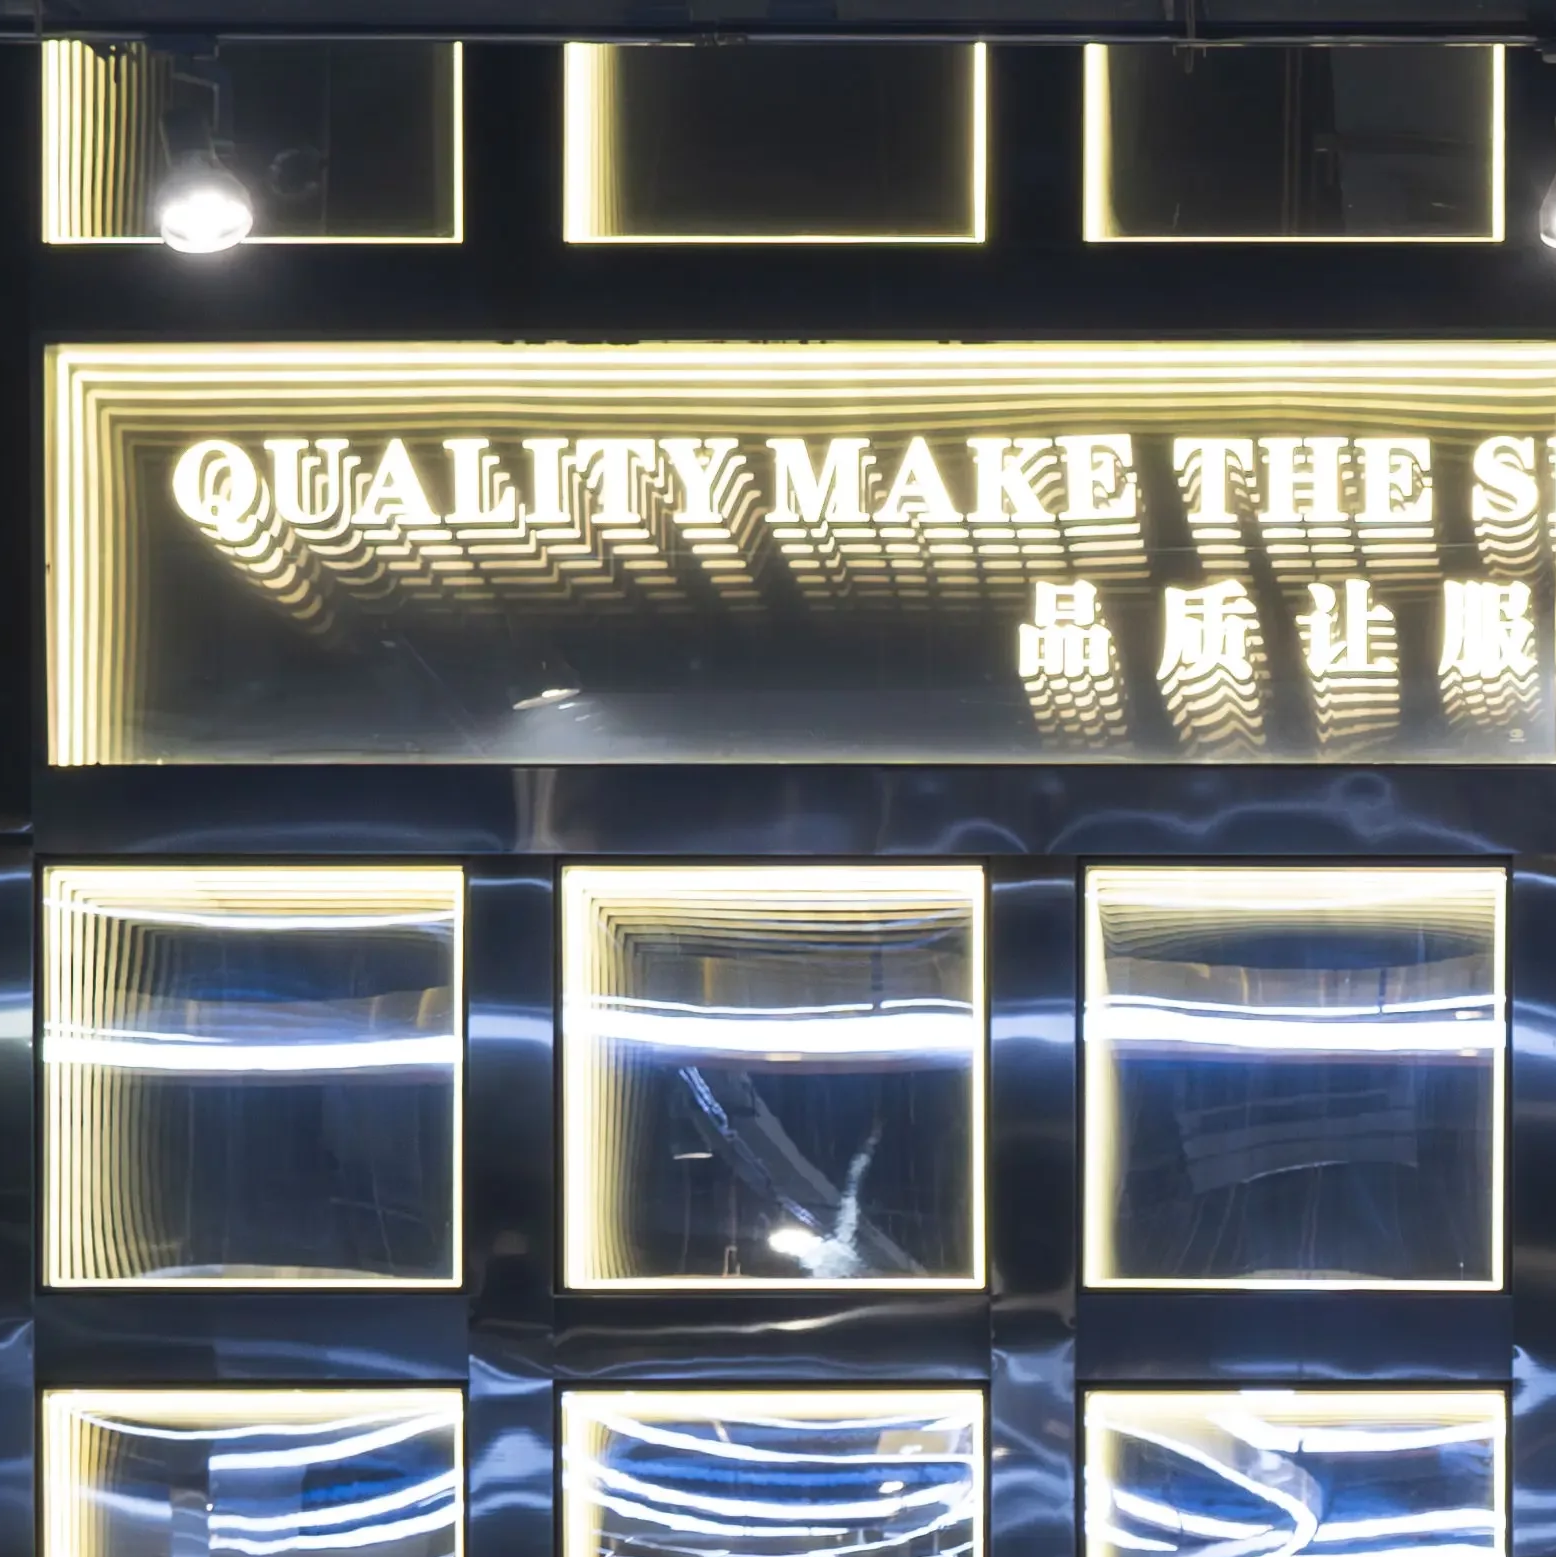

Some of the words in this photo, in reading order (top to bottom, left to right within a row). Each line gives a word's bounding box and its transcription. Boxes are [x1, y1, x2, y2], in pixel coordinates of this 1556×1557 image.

[172, 437, 740, 543] QUALITY
[764, 433, 1138, 525] MAKE
[1172, 436, 1434, 523] THE
